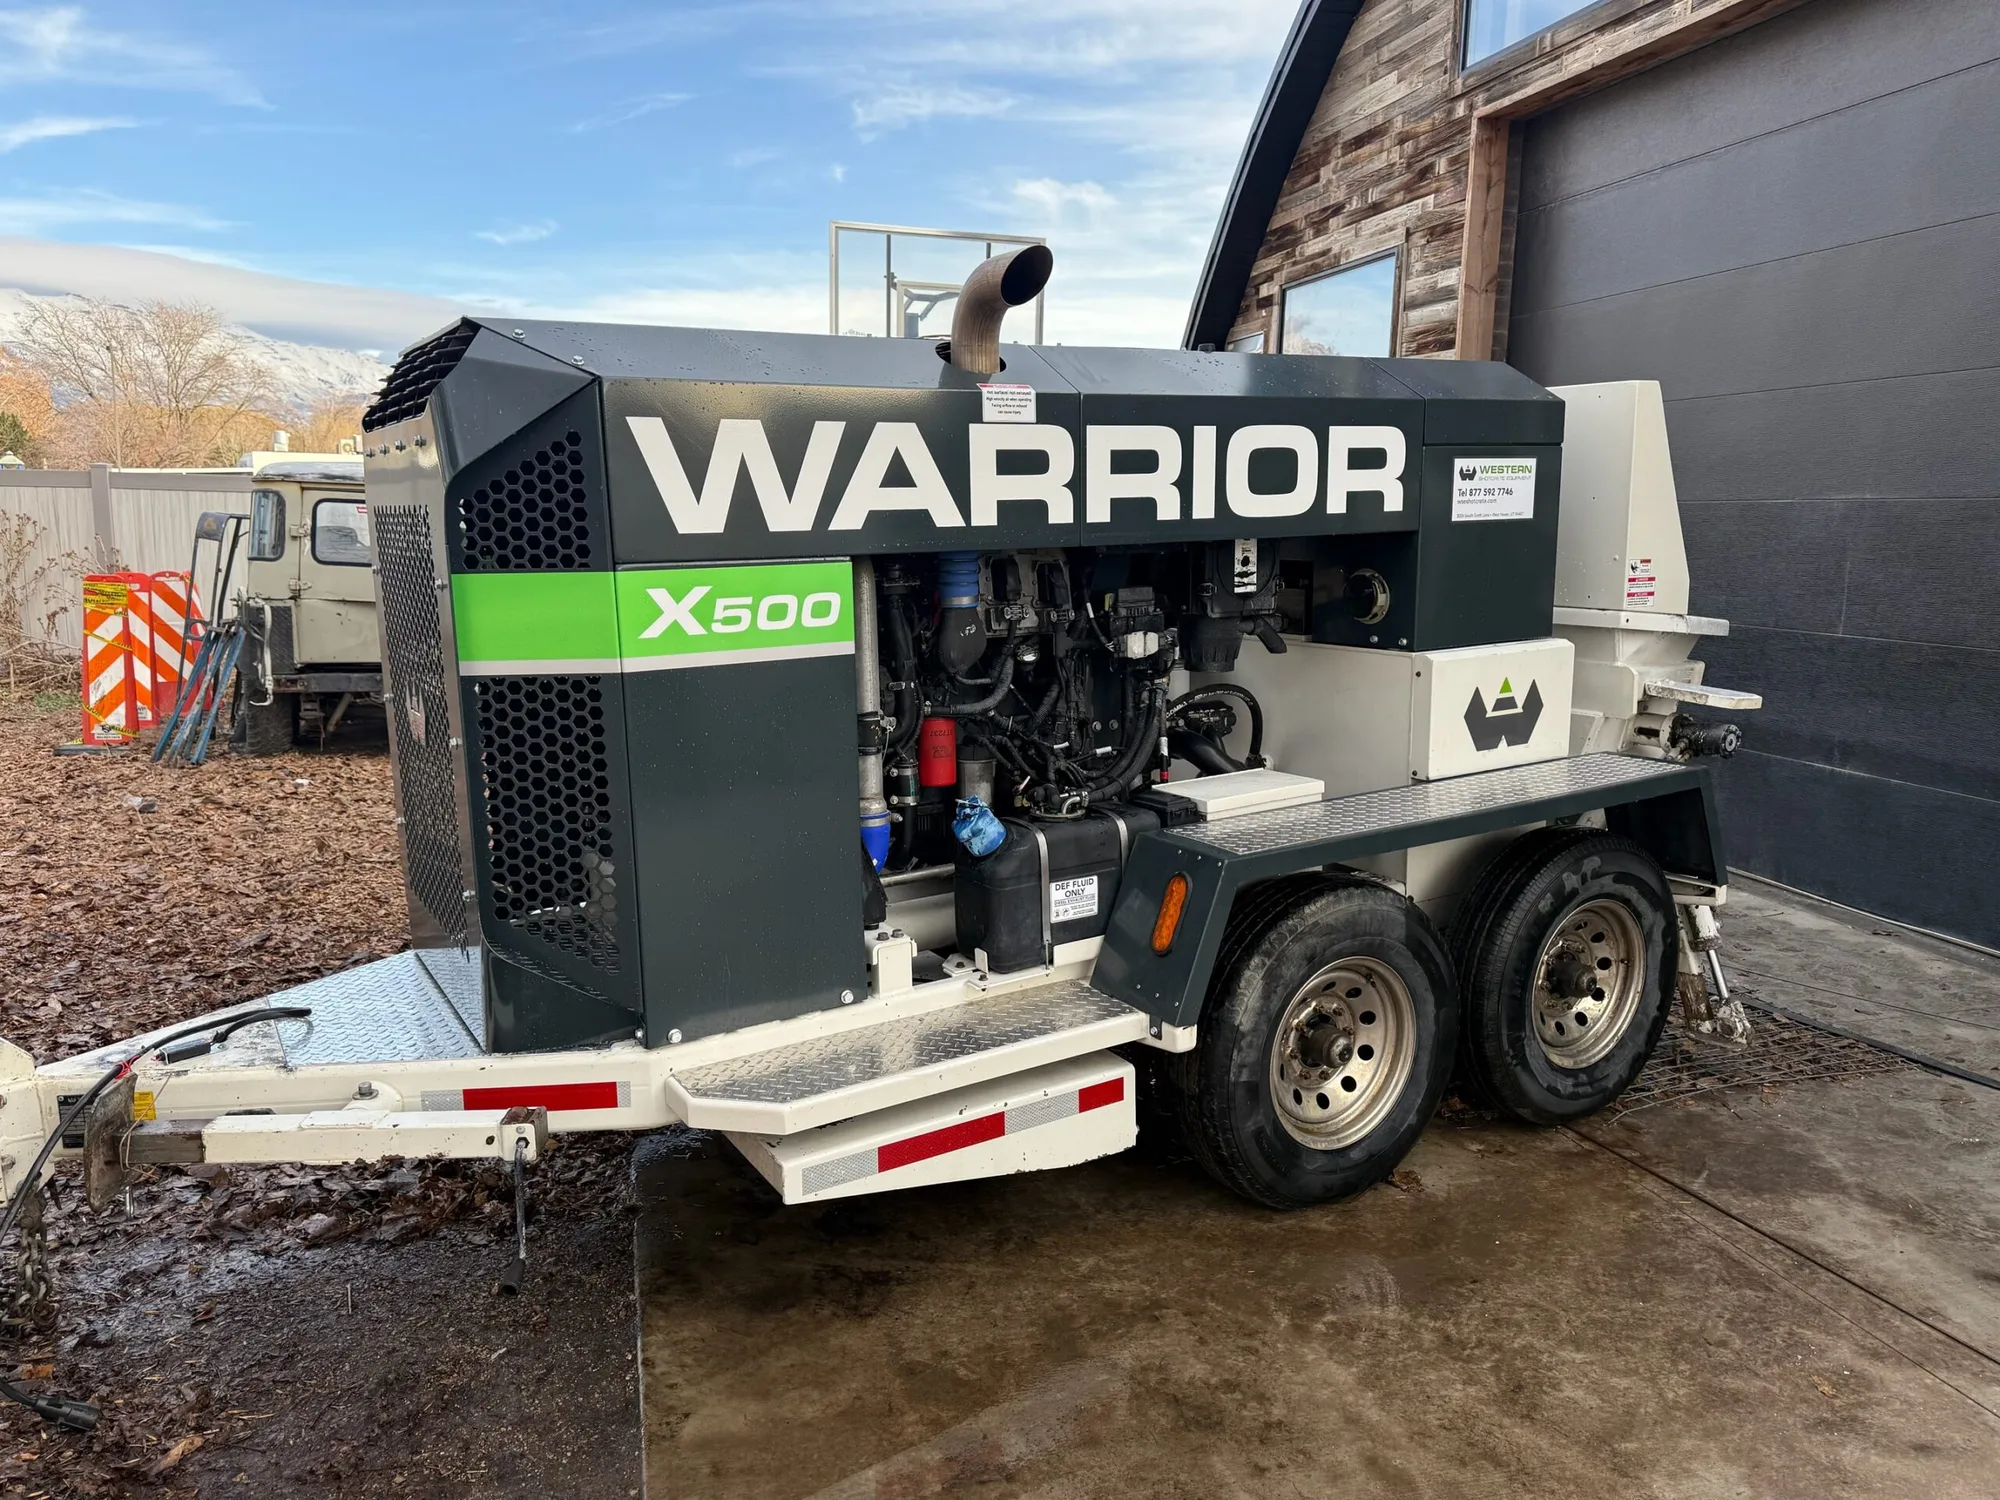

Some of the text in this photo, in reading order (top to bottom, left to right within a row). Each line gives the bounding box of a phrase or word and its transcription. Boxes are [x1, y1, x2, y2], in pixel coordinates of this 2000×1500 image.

[625, 416, 1407, 534] WARRIOR
[1479, 465, 1532, 474] WESTERN
[1457, 487, 1514, 497] Tel 877 592 7746
[638, 586, 841, 639] X500
[1055, 878, 1094, 891] DEF FLUID
[1065, 888, 1085, 898] ONLY
